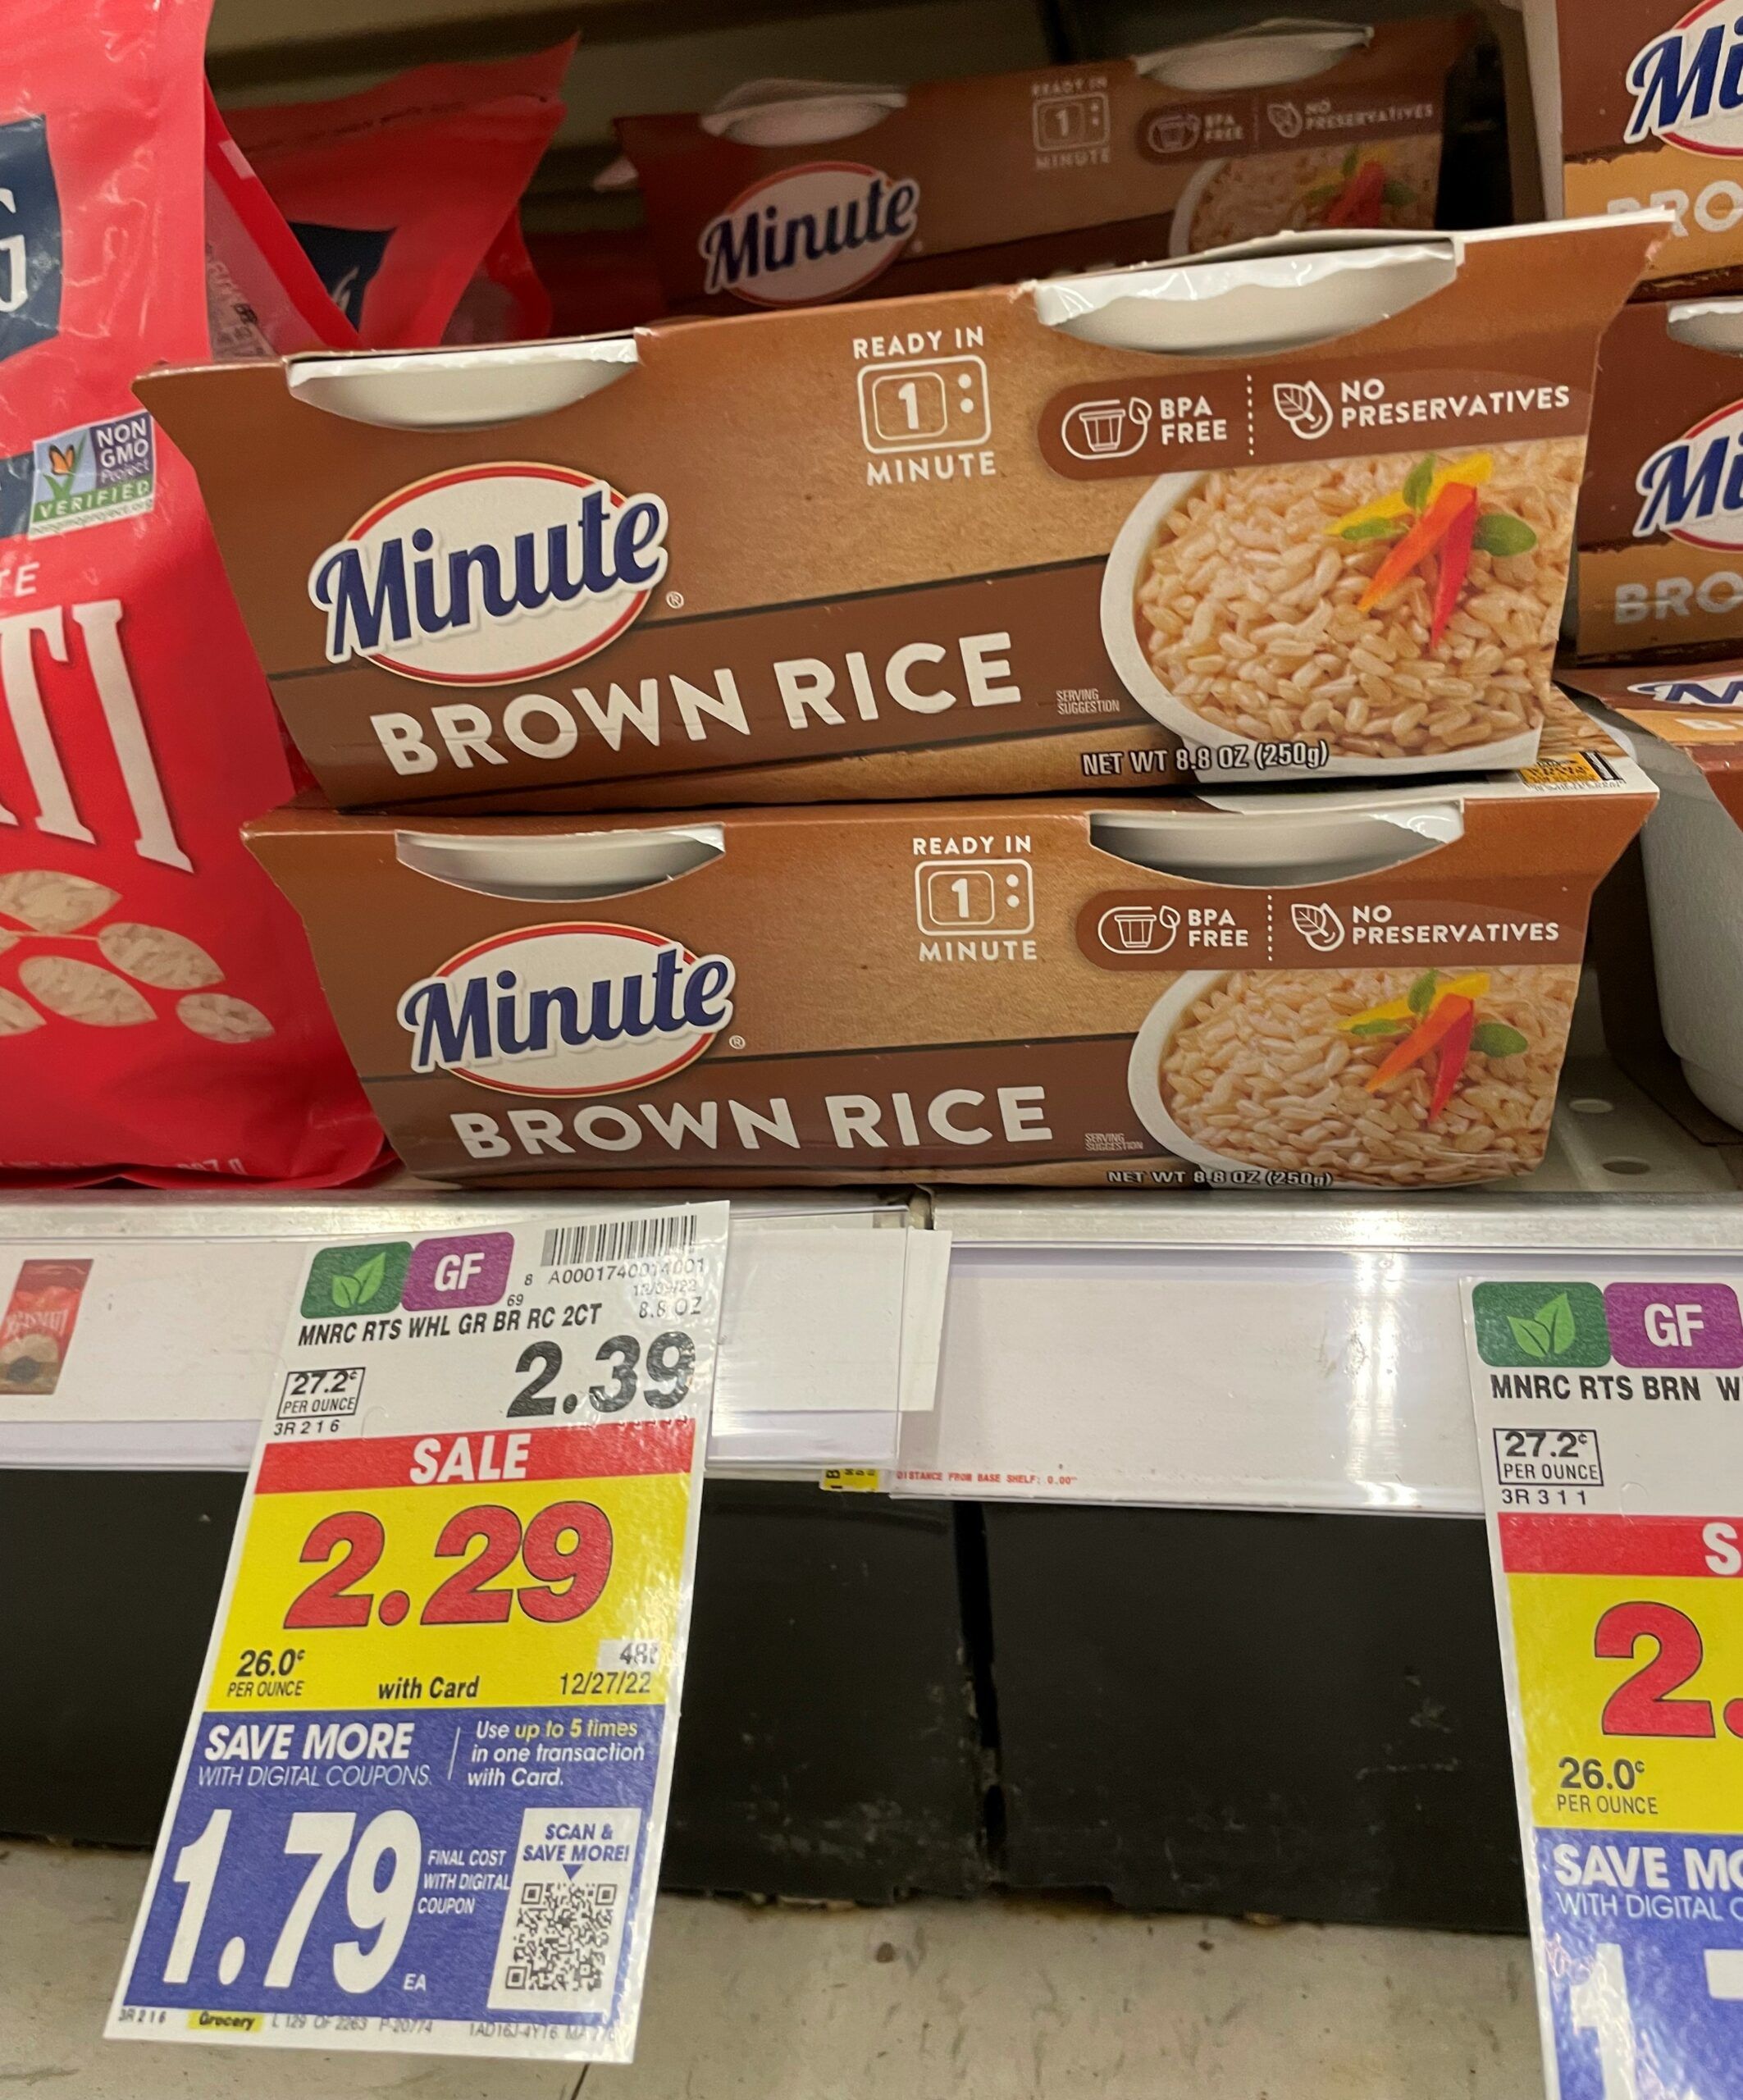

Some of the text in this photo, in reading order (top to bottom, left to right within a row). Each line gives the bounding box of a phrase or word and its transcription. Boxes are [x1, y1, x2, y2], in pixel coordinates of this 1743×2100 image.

[704, 178, 916, 290] Minute
[852, 326, 984, 359] READY IN
[1340, 378, 1385, 402] NO
[897, 381, 919, 431] 1
[1160, 395, 1213, 419] BPA
[1341, 386, 1570, 429] PRESERVATIVES
[96, 418, 147, 449] NON
[1161, 419, 1227, 445] FREE
[99, 437, 149, 468] GMO
[866, 451, 997, 486] MINUTE
[39, 480, 151, 518] VERIFIED
[314, 490, 662, 656] Minute
[1614, 570, 1743, 625] BRO
[369, 631, 1022, 776] BROWN RICE
[1056, 688, 1099, 703] SERVING
[1056, 699, 1120, 715] SUGGESTION
[1081, 738, 1330, 776] NET WT 8.8 OZ (250g)
[912, 834, 1032, 856] READY IN
[951, 877, 970, 919] 1
[1188, 908, 1237, 928] BPA
[1352, 904, 1393, 924] NO
[1188, 929, 1249, 948] FREE
[1352, 921, 1559, 946] PRESERVATIVES
[918, 940, 1038, 962] MINUTE
[404, 947, 730, 1068] Minute
[449, 1084, 1053, 1160] BROWN RICE
[1084, 1132, 1125, 1144] SERVING
[1084, 1141, 1144, 1153] SUGGESTION
[1107, 1171, 1333, 1188] NET WT 8.8 OZ (250g)
[434, 1252, 486, 1292] GF
[524, 1273, 533, 1286] 8
[507, 1293, 524, 1308] 69
[674, 1295, 703, 1317] OZ
[298, 1302, 603, 1347] MNRC RTS WHL GR BR RC 2CT
[1643, 1303, 1705, 1348] GF
[506, 1330, 696, 1419] 2.39
[1490, 1373, 1743, 1402] MNRC RTS BRN W
[283, 1396, 356, 1414] PER OUNCE
[409, 1433, 532, 1485] SALE
[1503, 1462, 1599, 1481] PER OUNCE
[897, 1470, 943, 1481] DISTANCE
[948, 1472, 973, 1482] FROM
[977, 1472, 1002, 1483] BASE
[1006, 1473, 1042, 1485] SHELF:
[282, 1500, 614, 1630] 2.29
[226, 1679, 305, 1698] PER OUNCE
[378, 1675, 480, 1701] with Card
[559, 1670, 651, 1696] 12/27/22
[204, 1722, 416, 1761] SAVE MORE
[475, 1719, 638, 1744] Use up to 5 times
[471, 1742, 646, 1763] in one transaction
[197, 1764, 433, 1787] WITH DIGITAL COUPONS.
[468, 1766, 564, 1787] with Card.
[1556, 1793, 1659, 1815] PER OUNCE
[545, 1822, 614, 1842] SCAN &
[427, 1848, 507, 1867] FINAL COST
[522, 1844, 630, 1863] SAVE MORE!
[1552, 1843, 1671, 1889] SAVE
[423, 1872, 511, 1892] WITH DIGITAL
[162, 1808, 423, 1995] 1.79
[417, 1897, 476, 1915] COUPON
[1555, 1890, 1618, 1918] WITH
[1625, 1893, 1725, 1922] DIGITAL
[402, 1974, 427, 1993] EA
[198, 2010, 256, 2031] Grocery
